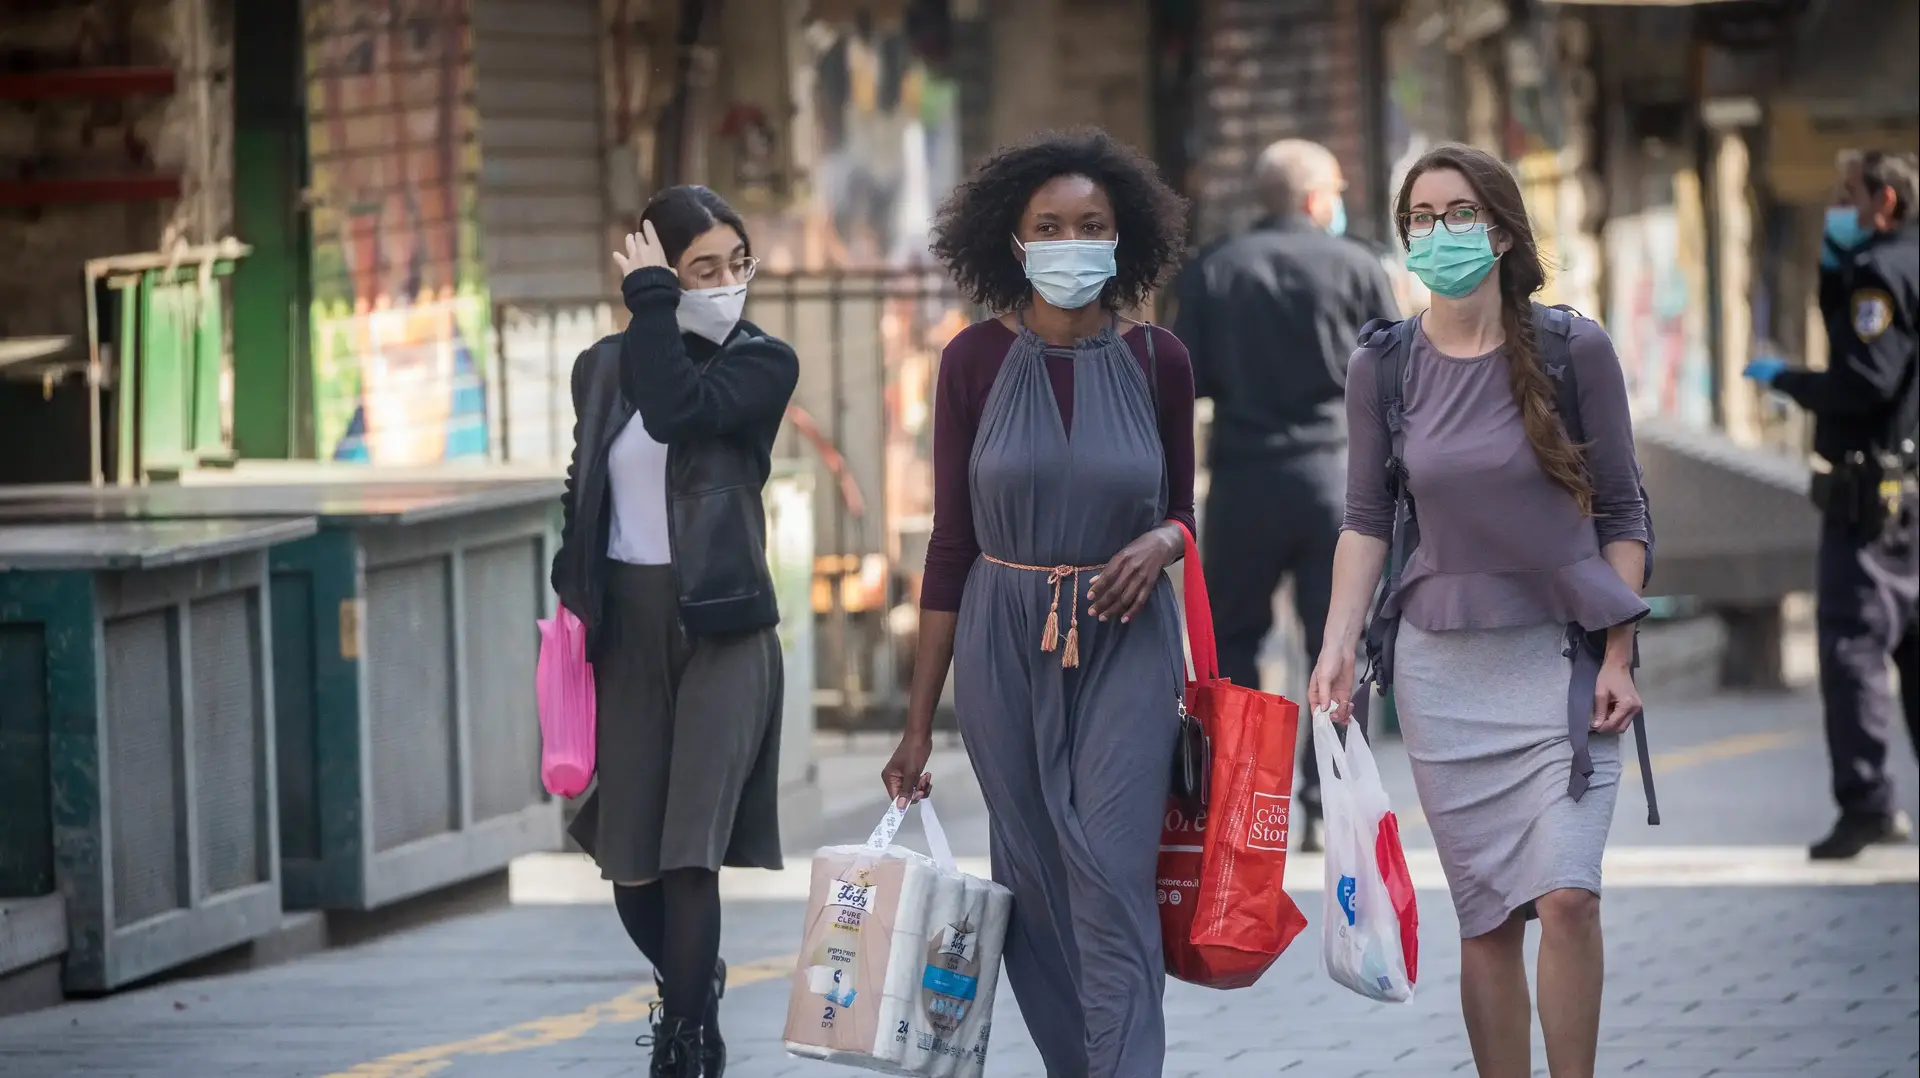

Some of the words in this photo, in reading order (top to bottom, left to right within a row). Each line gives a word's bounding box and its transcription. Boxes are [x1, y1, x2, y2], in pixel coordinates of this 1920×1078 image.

[1270, 804, 1287, 814] The
[1256, 808, 1288, 825] Coo
[1157, 877, 1199, 887] store.co.il
[841, 909, 861, 920] PURE
[897, 1020, 910, 1035] 24
